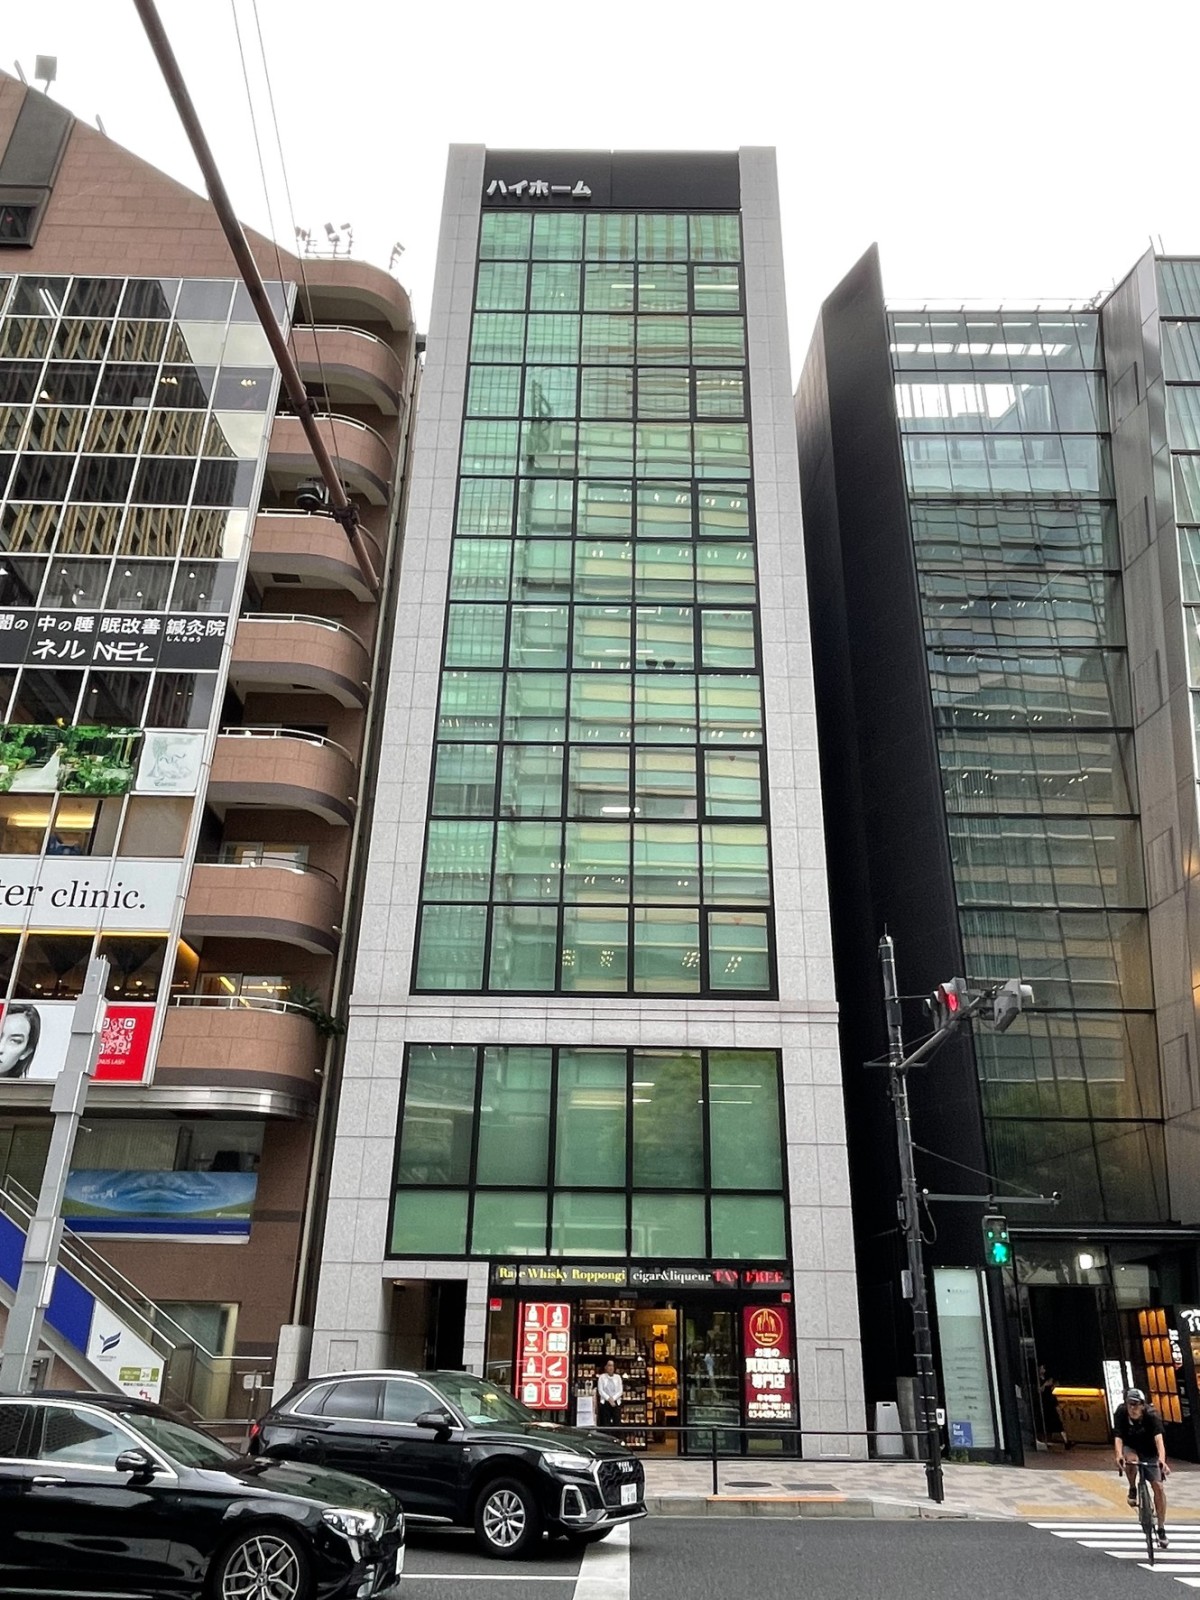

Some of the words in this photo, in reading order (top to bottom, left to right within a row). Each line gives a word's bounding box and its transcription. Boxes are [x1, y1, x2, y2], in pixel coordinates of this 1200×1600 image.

[487, 180, 592, 198] ハイホーム
[32, 638, 86, 660] ネル
[92, 641, 155, 662] NEL
[51, 880, 146, 909] clinic.
[527, 1267, 568, 1282] Whisky
[571, 1268, 626, 1283] Roppongi
[632, 1269, 712, 1284] cigar&liqueur
[746, 1270, 785, 1283] FREE
